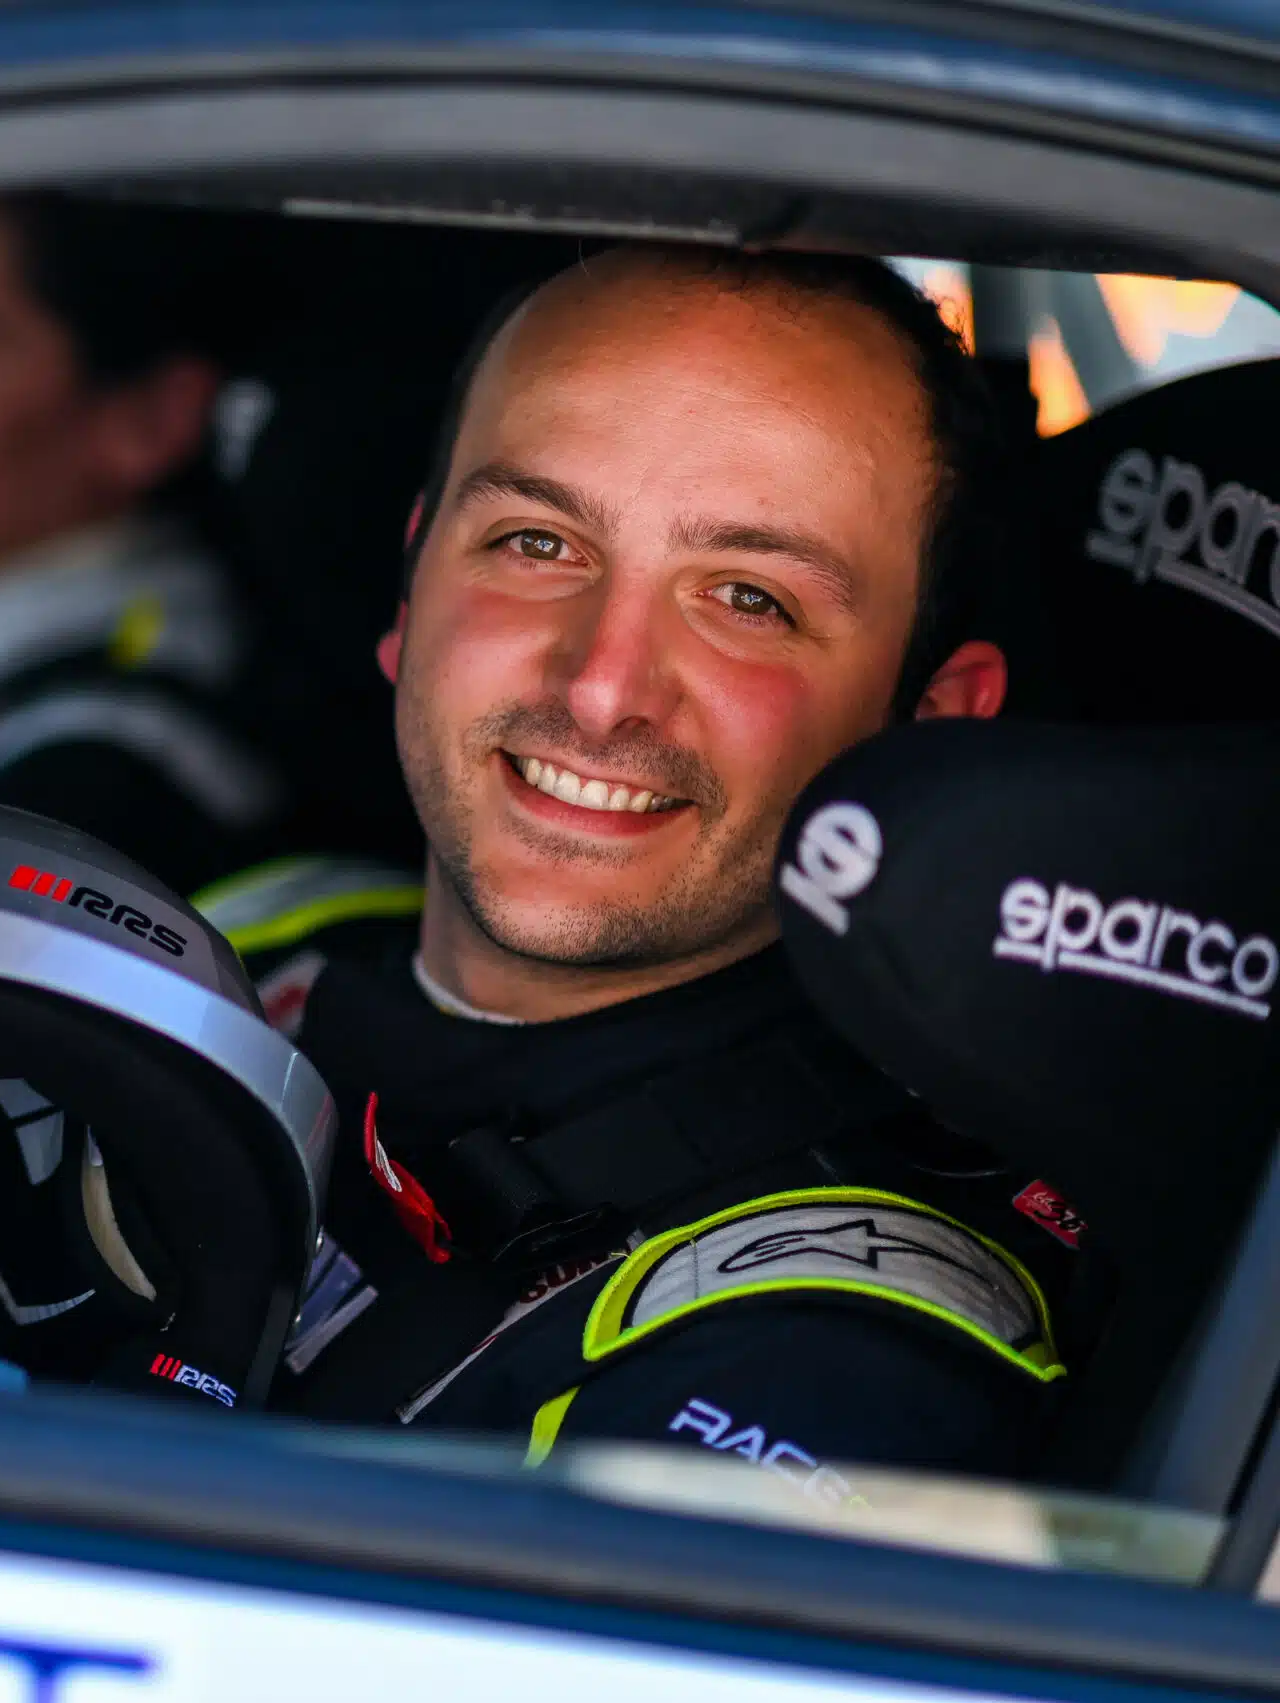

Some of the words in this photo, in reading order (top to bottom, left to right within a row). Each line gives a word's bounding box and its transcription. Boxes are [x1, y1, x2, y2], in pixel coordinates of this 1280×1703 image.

[1087, 449, 1280, 610] spar
[67, 885, 189, 958] RRS
[994, 876, 1280, 1018] sparco
[173, 1364, 237, 1407] RRS
